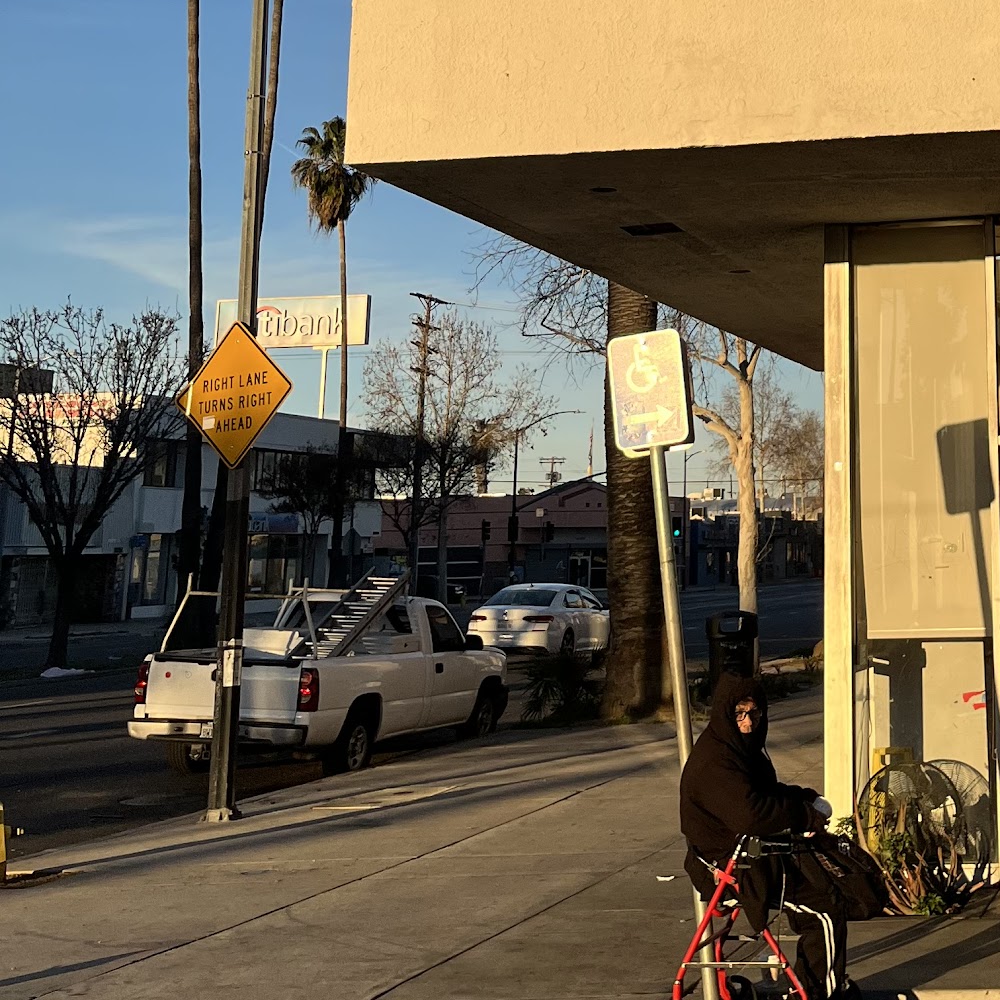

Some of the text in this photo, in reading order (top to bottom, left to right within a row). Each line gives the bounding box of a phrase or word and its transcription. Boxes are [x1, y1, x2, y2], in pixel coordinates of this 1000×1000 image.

[256, 307, 343, 338] tibank
[203, 370, 268, 393] RIGHT LANE
[198, 391, 273, 415] TURNS RIGHT
[215, 415, 253, 433] AHEAD
